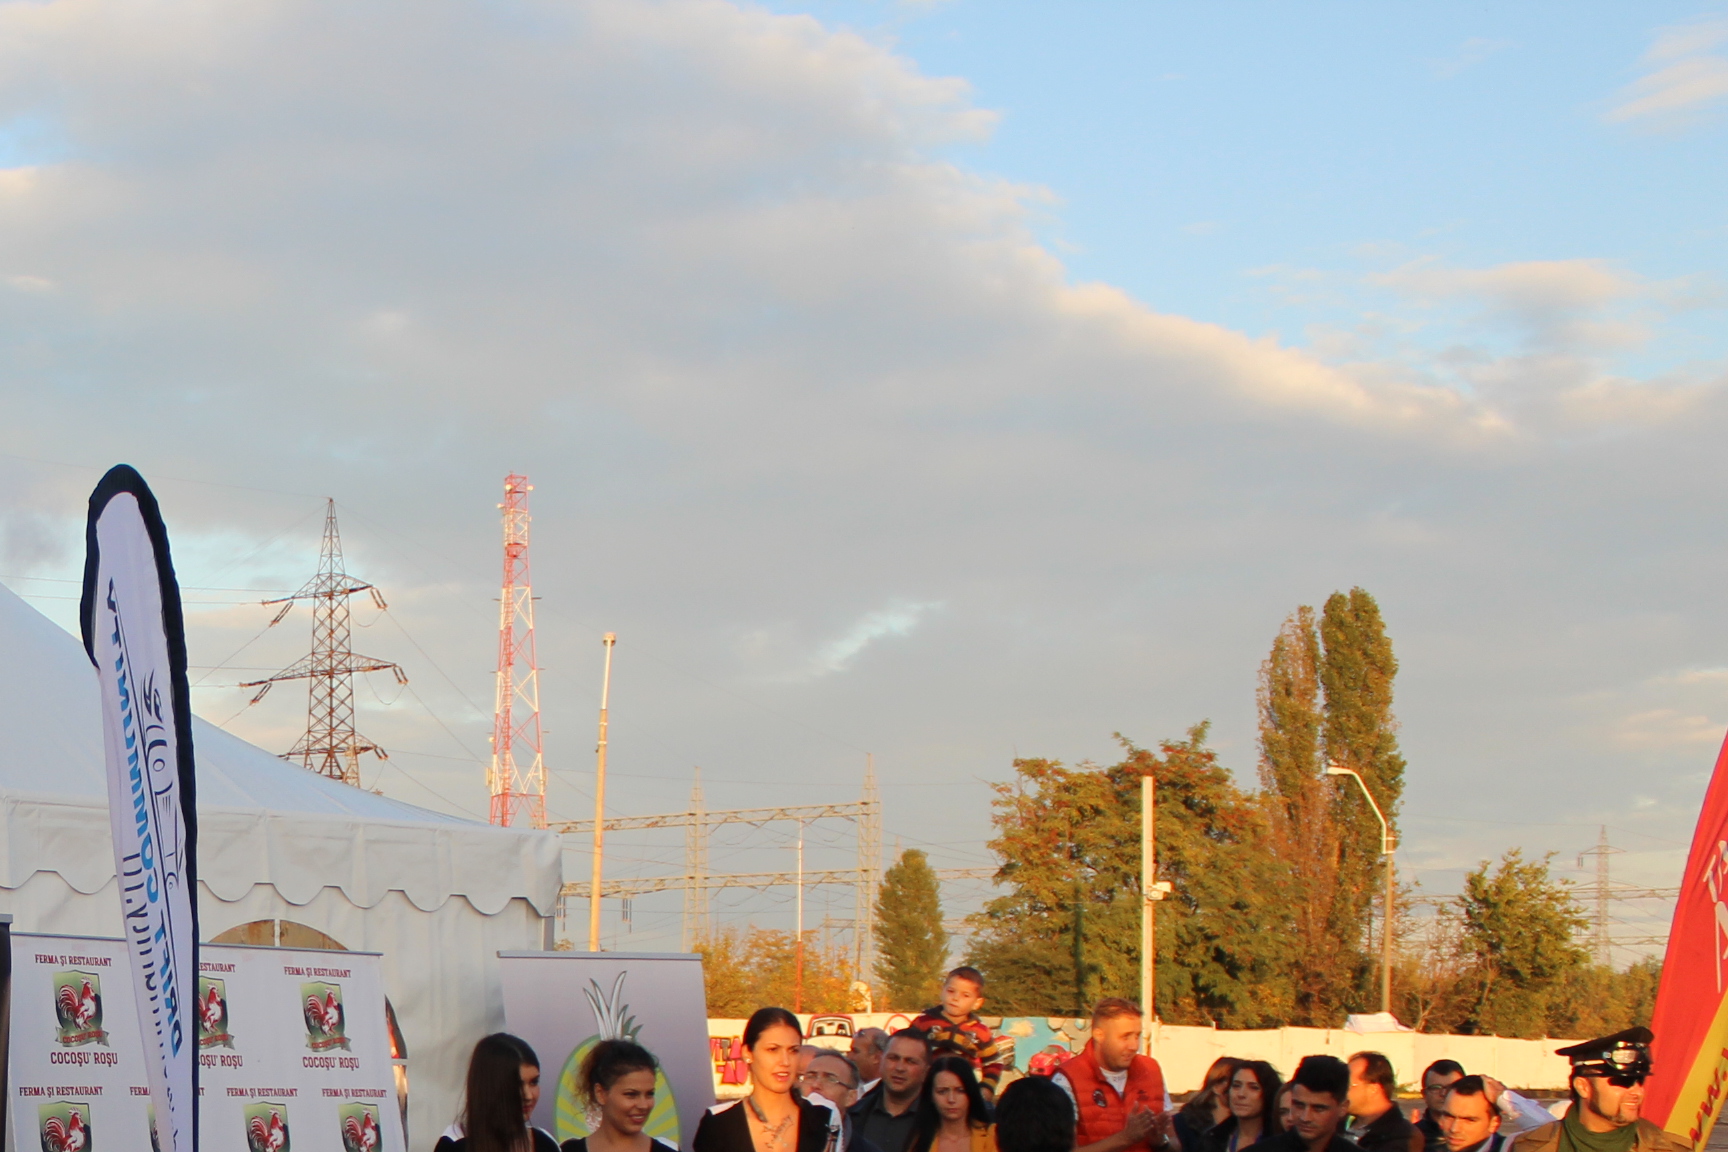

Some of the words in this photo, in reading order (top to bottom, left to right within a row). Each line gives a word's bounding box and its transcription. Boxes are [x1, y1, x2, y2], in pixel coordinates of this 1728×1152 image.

[35, 954, 57, 963] FERMA
[69, 956, 112, 967] RESTAURANT
[284, 966, 305, 975] FERMA
[314, 969, 351, 978] RESTAURANT
[20, 1086, 45, 1096] FERMA
[56, 1086, 103, 1096] RESTAURANT
[227, 1088, 249, 1097] FERMA
[258, 1088, 298, 1097] RESTAURANT
[322, 1089, 344, 1097] FERMA
[352, 1089, 387, 1098] RESTAURANT
